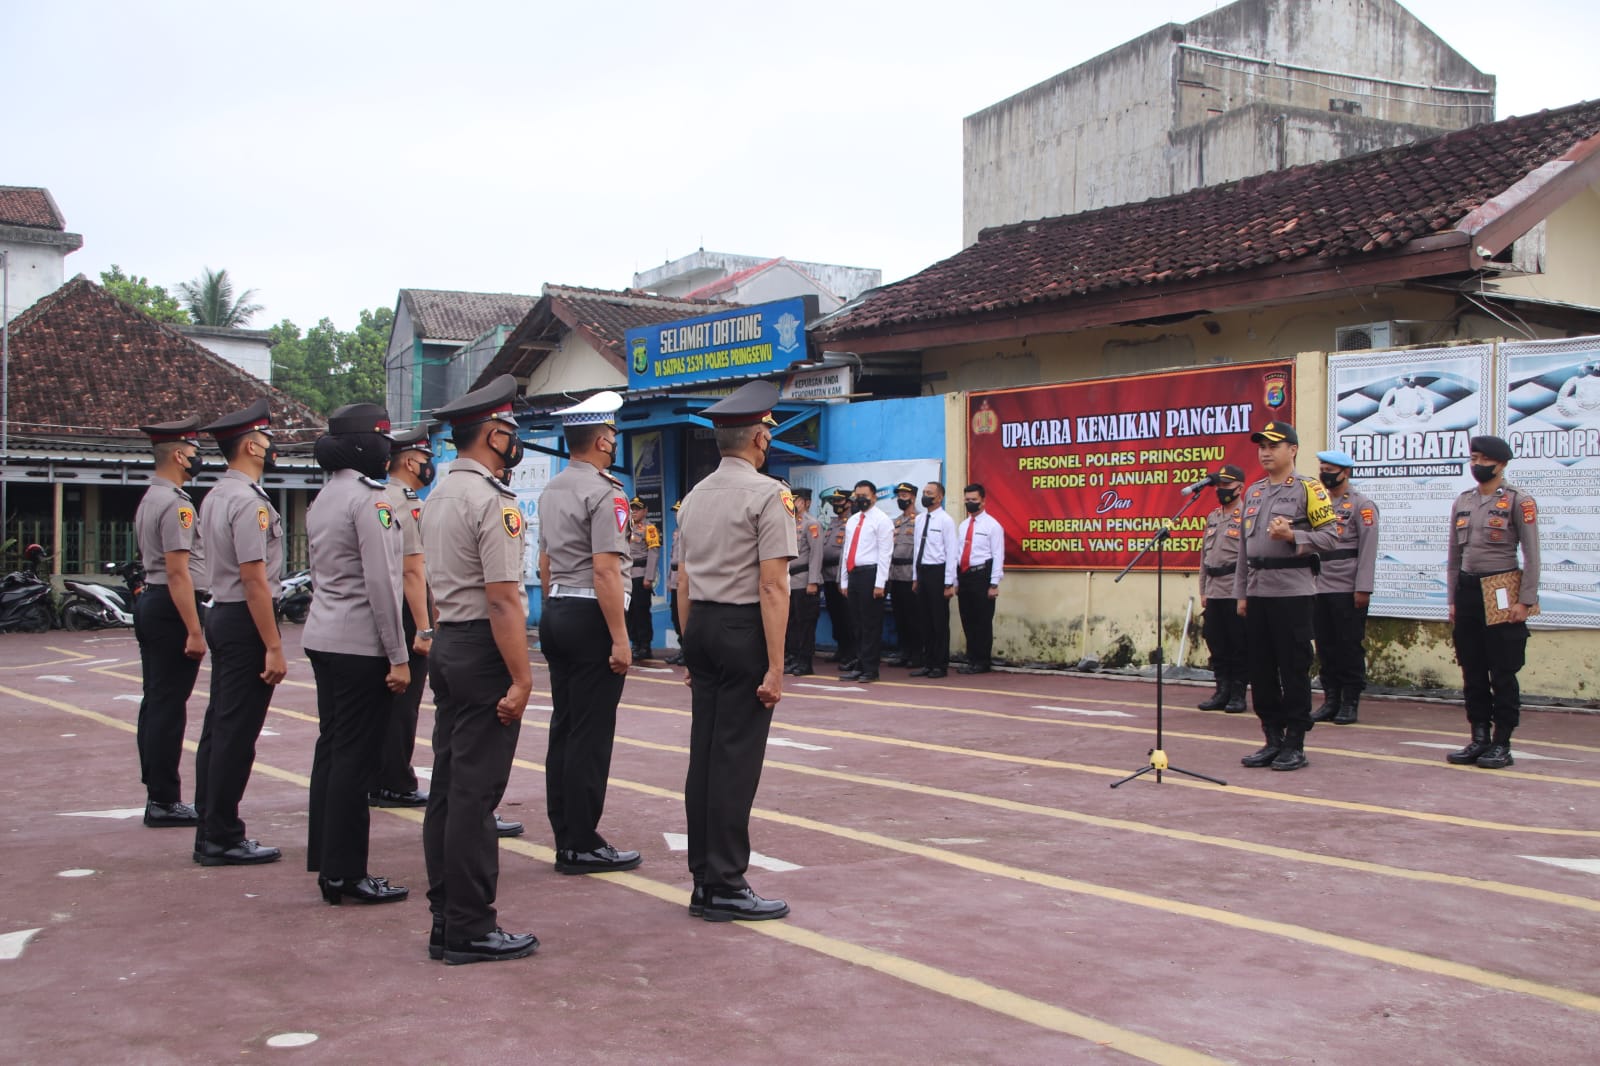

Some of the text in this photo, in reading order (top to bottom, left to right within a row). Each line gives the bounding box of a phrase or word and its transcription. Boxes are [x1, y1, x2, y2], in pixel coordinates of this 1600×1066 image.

[660, 313, 762, 354] SELAMAT DATANG
[654, 343, 772, 377] DI SATPAS 2539 POLRES PRINGSEWU
[823, 374, 839, 386] ANDA
[1001, 403, 1252, 449] UPACARA KENAIKAN PANGKAT
[1340, 430, 1472, 462] TRI BRATA
[1508, 430, 1569, 459] CATUR
[1018, 446, 1225, 471] PERSONEL POLRES PRINGSEWU
[1352, 464, 1461, 477] KAMI POLISI INDONESIA
[1032, 467, 1208, 489] PERIODE 01 JANUARI 2023
[1096, 490, 1132, 514] Dan
[1029, 518, 1102, 533] PEMBERIAN
[1022, 538, 1085, 552] PERSONEL
[1087, 537, 1124, 552] YANG
